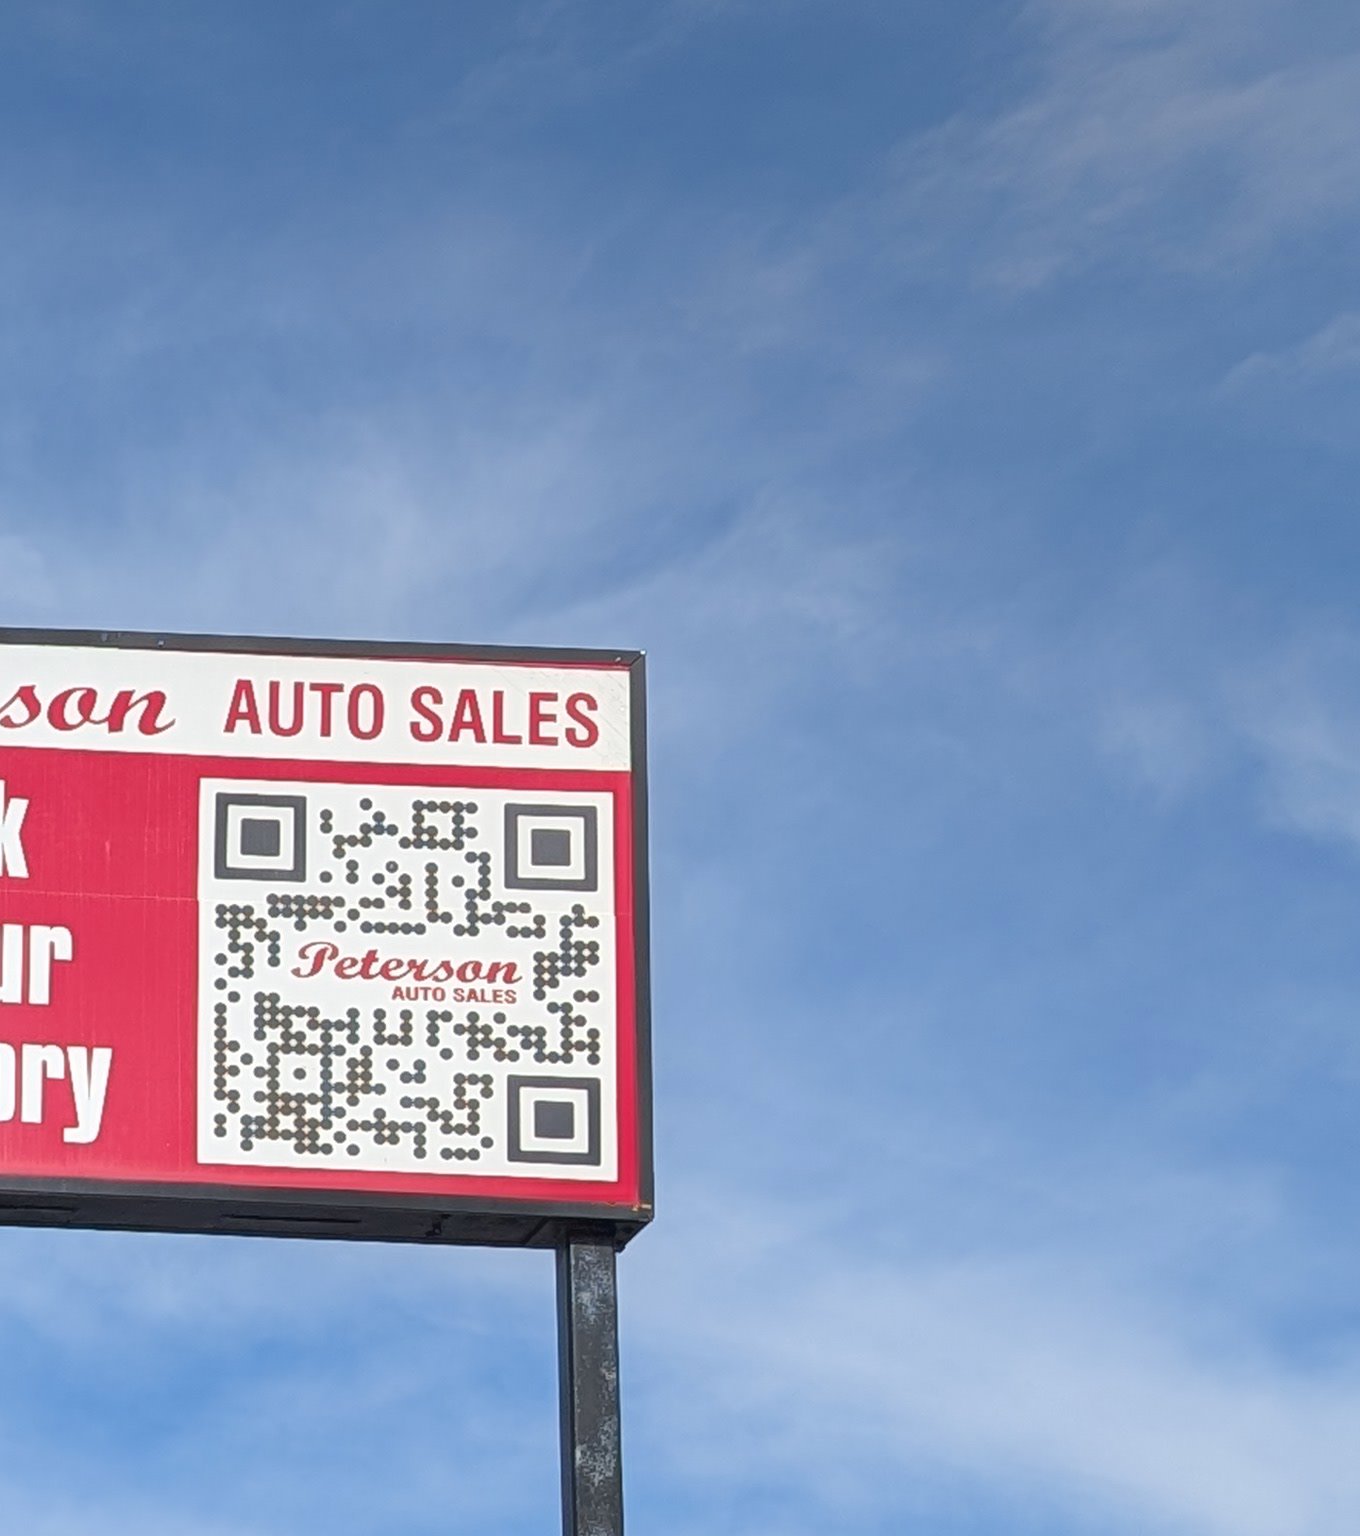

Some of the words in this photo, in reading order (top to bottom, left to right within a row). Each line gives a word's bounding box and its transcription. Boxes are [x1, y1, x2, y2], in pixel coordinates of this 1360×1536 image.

[223, 678, 385, 740] AUTO
[408, 685, 600, 749] SALES
[290, 941, 523, 985] Peterson
[391, 985, 446, 1002] AUTO
[452, 987, 518, 1005] SALES
